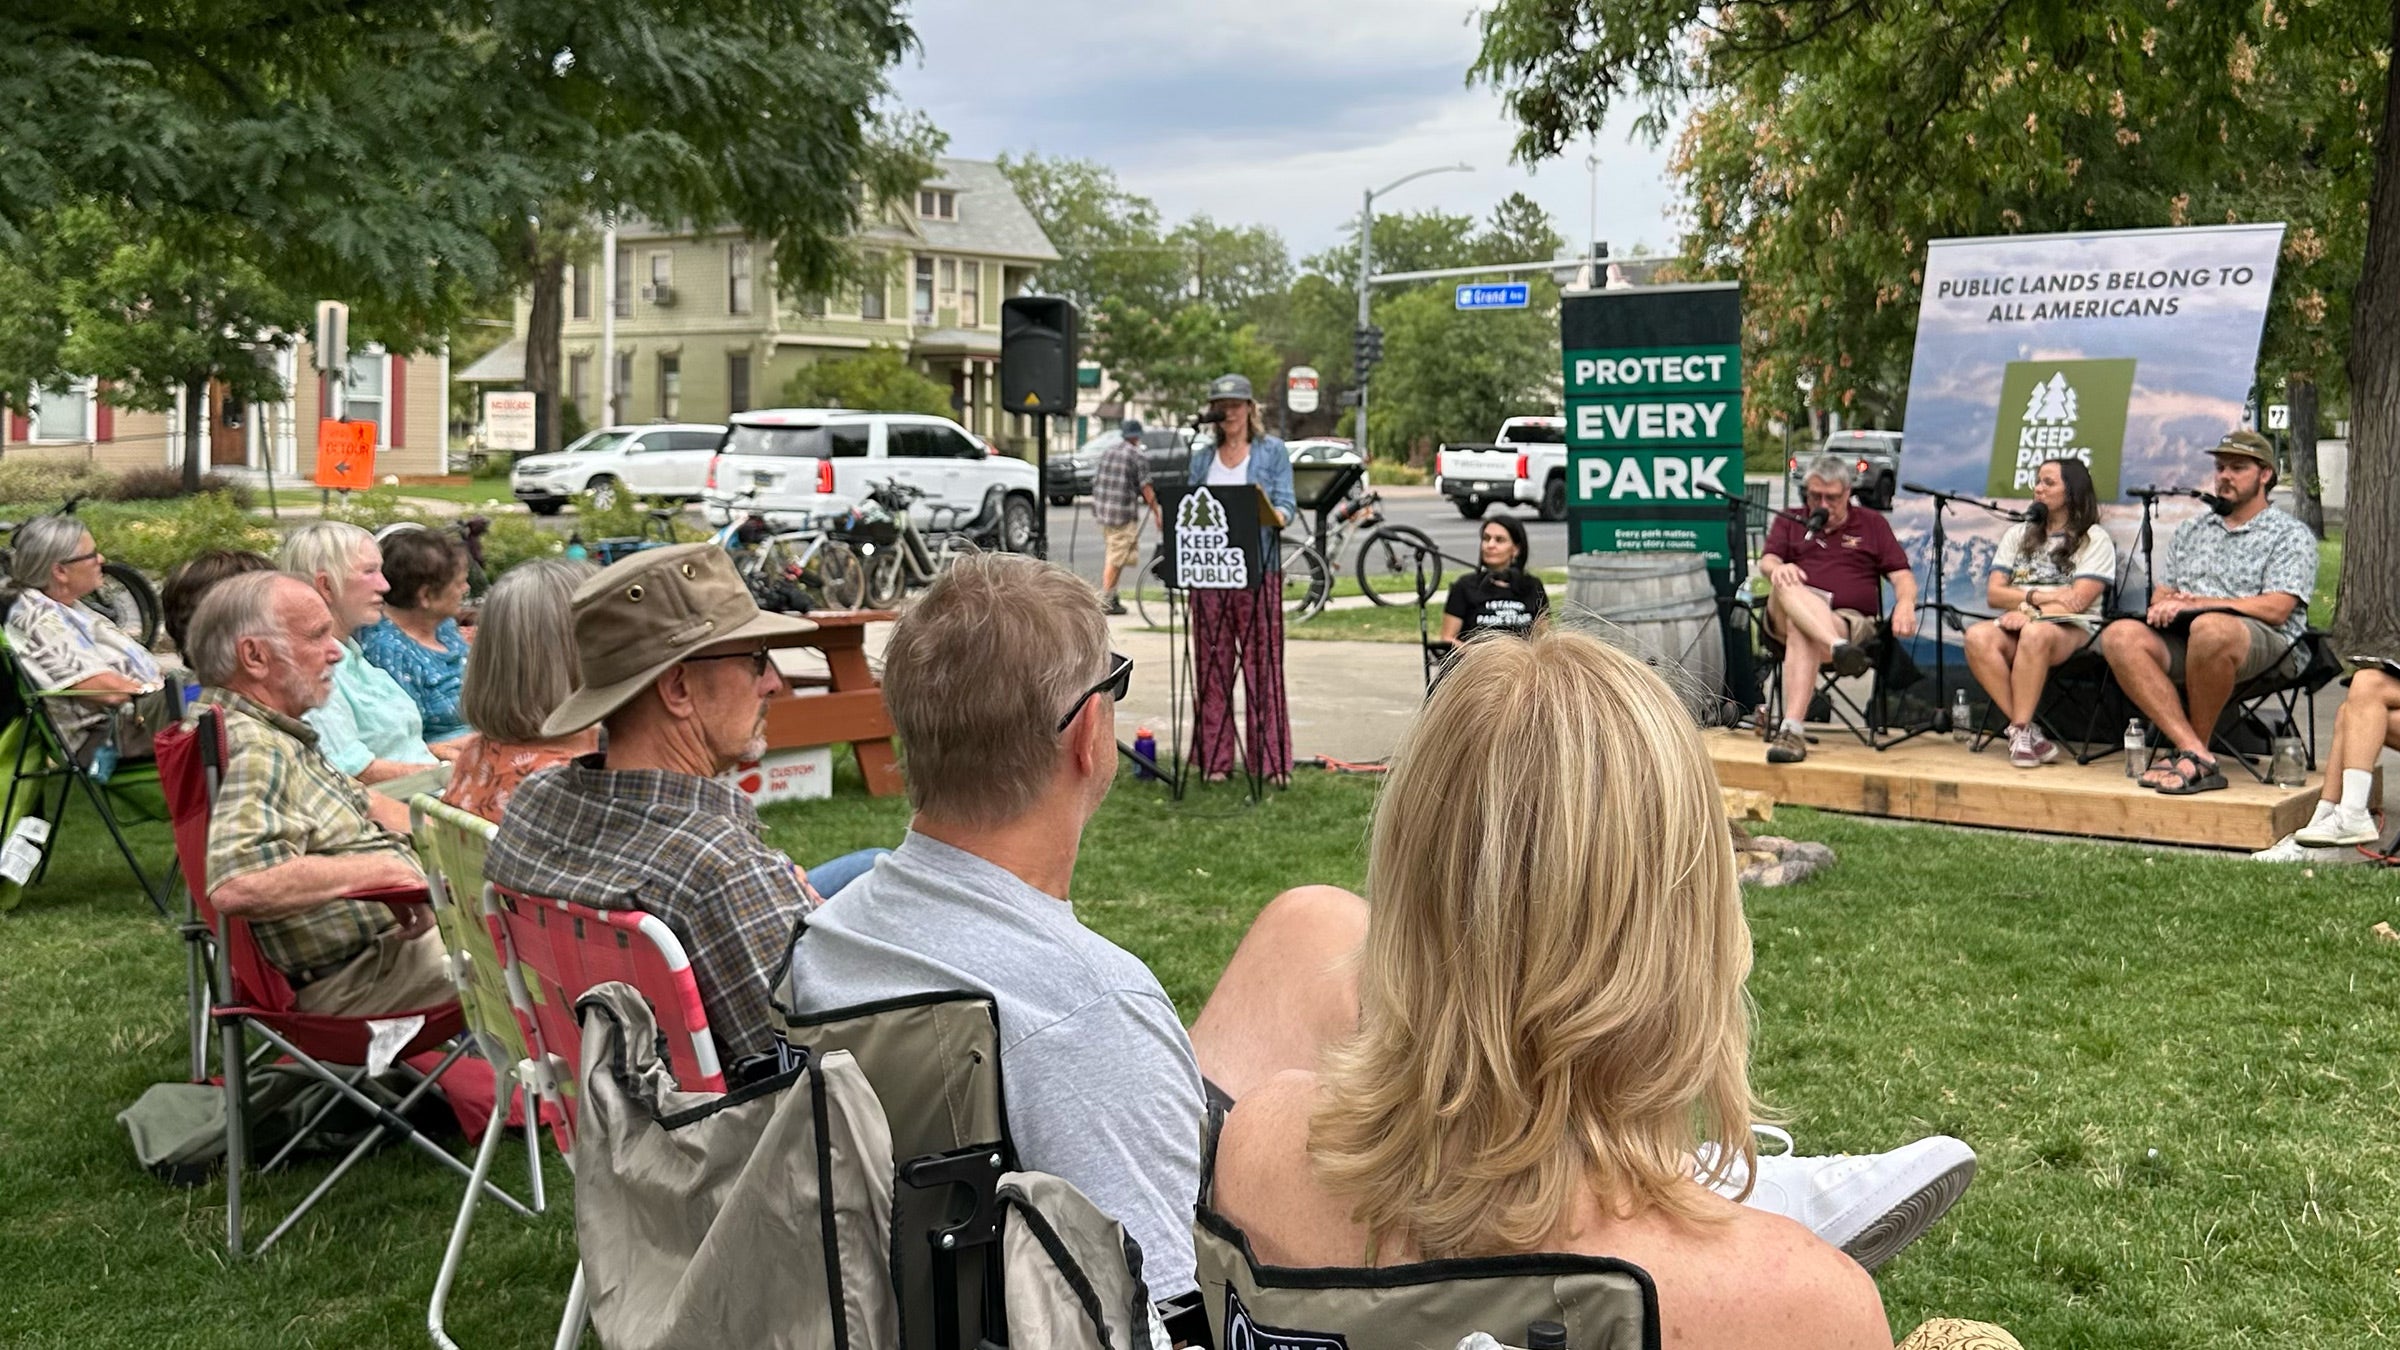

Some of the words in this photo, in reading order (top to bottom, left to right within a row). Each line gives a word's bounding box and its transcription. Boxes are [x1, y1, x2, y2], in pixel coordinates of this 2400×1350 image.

[1938, 277, 2014, 298] PUBLIC
[2019, 273, 2100, 294] LANDS
[2106, 269, 2210, 290] BELONG
[2219, 267, 2253, 286] TO
[1474, 288, 1507, 304] Grand
[1987, 304, 2025, 322] ALL
[2031, 297, 2179, 320] AMERICANS
[1575, 355, 1727, 385] PROTECT
[1576, 402, 1727, 440] EVERY
[2019, 426, 2075, 448] KEEP
[326, 442, 370, 456] DETOUR
[1578, 456, 1728, 500] PARK
[1181, 534, 1224, 549] KEEP
[1615, 529, 1640, 539] Every
[1641, 529, 1661, 538] park
[1616, 540, 1641, 549] Every
[1181, 551, 1241, 566] PARKS
[1181, 568, 1243, 583] PUBLIC
[768, 764, 815, 778] CUSTOM
[770, 781, 789, 792] INK
